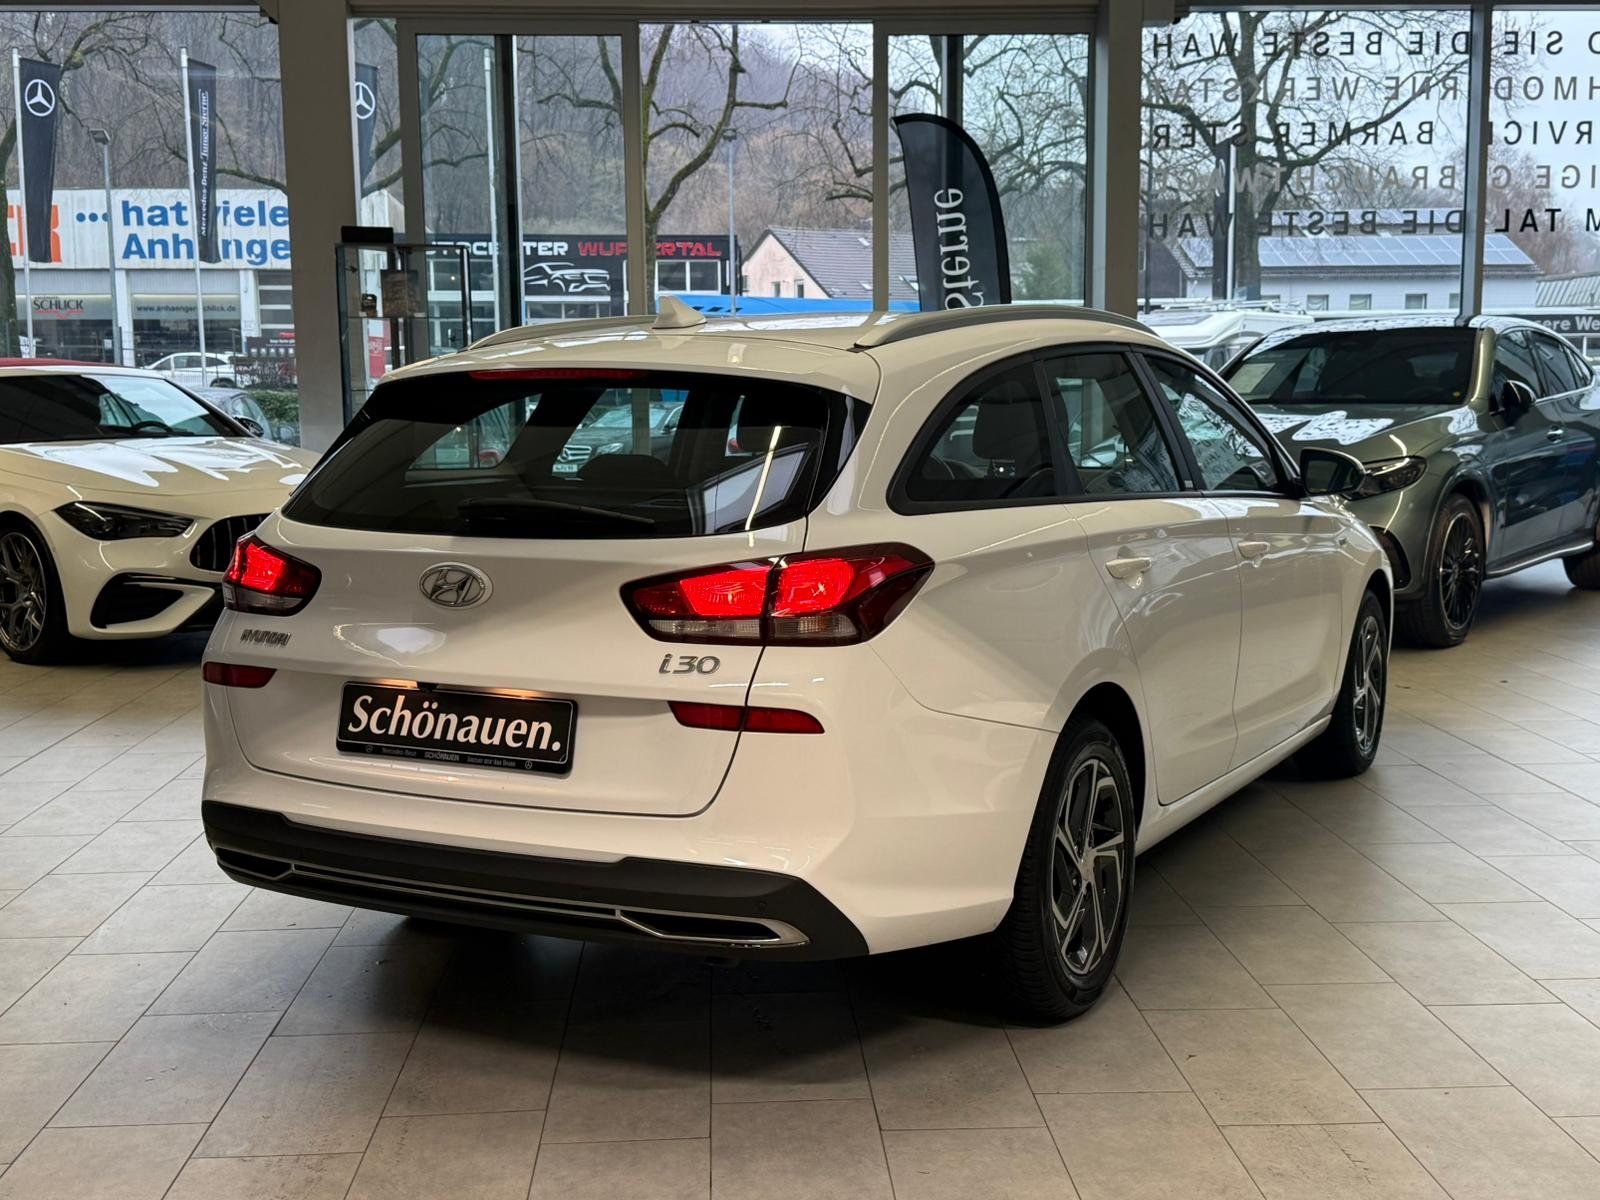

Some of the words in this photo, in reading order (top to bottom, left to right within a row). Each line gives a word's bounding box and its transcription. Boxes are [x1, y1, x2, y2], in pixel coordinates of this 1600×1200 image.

[122, 200, 188, 226] hat
[217, 200, 289, 226] iele
[122, 233, 291, 266] Anhnge
[659, 653, 721, 675] i30
[347, 695, 562, 752] Schönauen.
